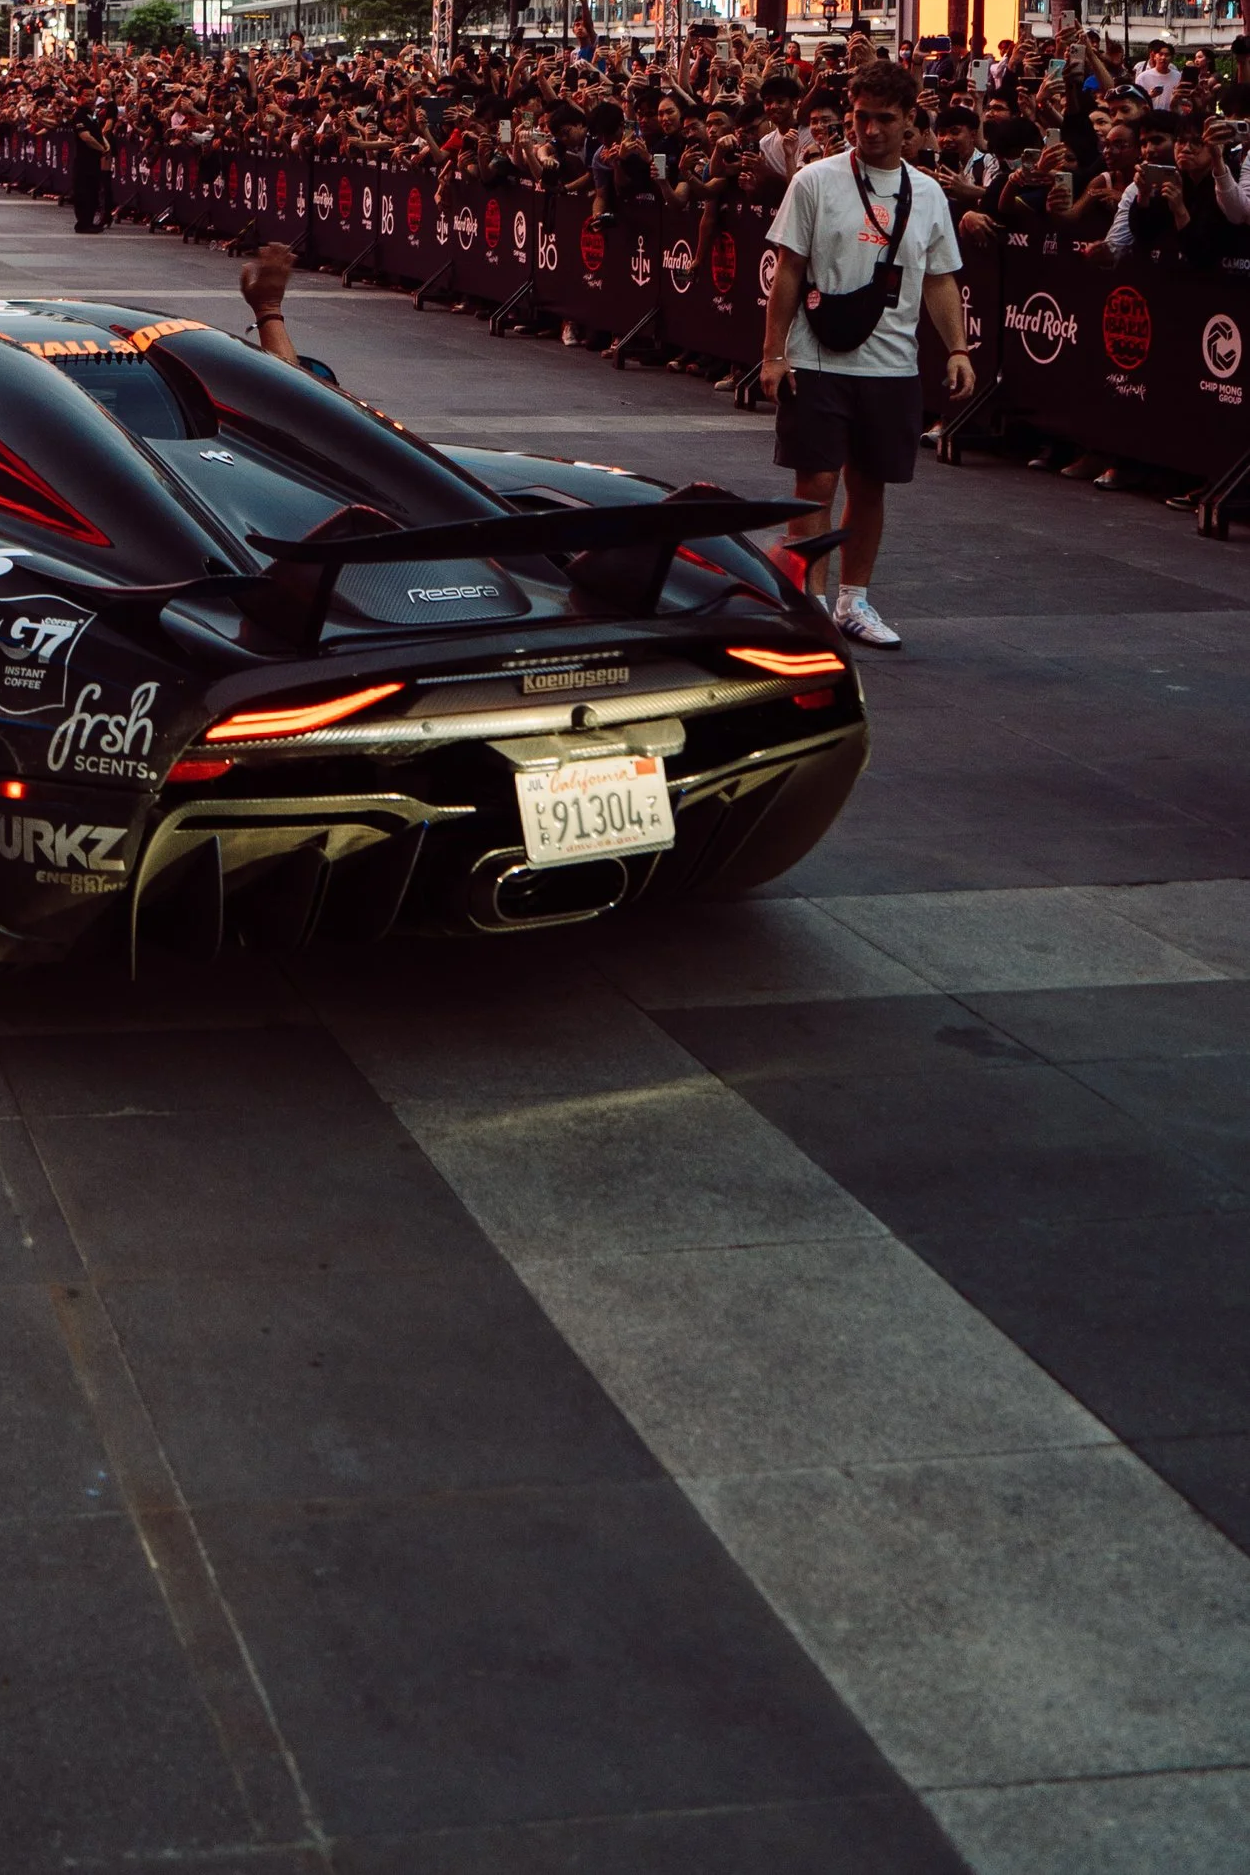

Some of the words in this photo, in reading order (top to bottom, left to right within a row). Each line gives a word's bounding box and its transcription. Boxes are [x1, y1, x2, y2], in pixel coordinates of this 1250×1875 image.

[1005, 304, 1043, 333] Hard
[1042, 310, 1079, 346] Rock
[1200, 380, 1217, 392] CHIP
[1218, 383, 1242, 397] MONG
[1218, 393, 1242, 405] GROUP
[407, 585, 499, 604] Regera
[43, 616, 78, 628] COFFEE
[4, 665, 46, 680] INSTANT
[523, 666, 630, 695] Koenigsegg
[4, 677, 42, 690] COFFEE
[47, 681, 161, 772] frsh
[527, 779, 545, 792] JUL
[550, 767, 639, 795] California
[552, 789, 644, 844] 91304
[35, 869, 110, 885] ENERGY
